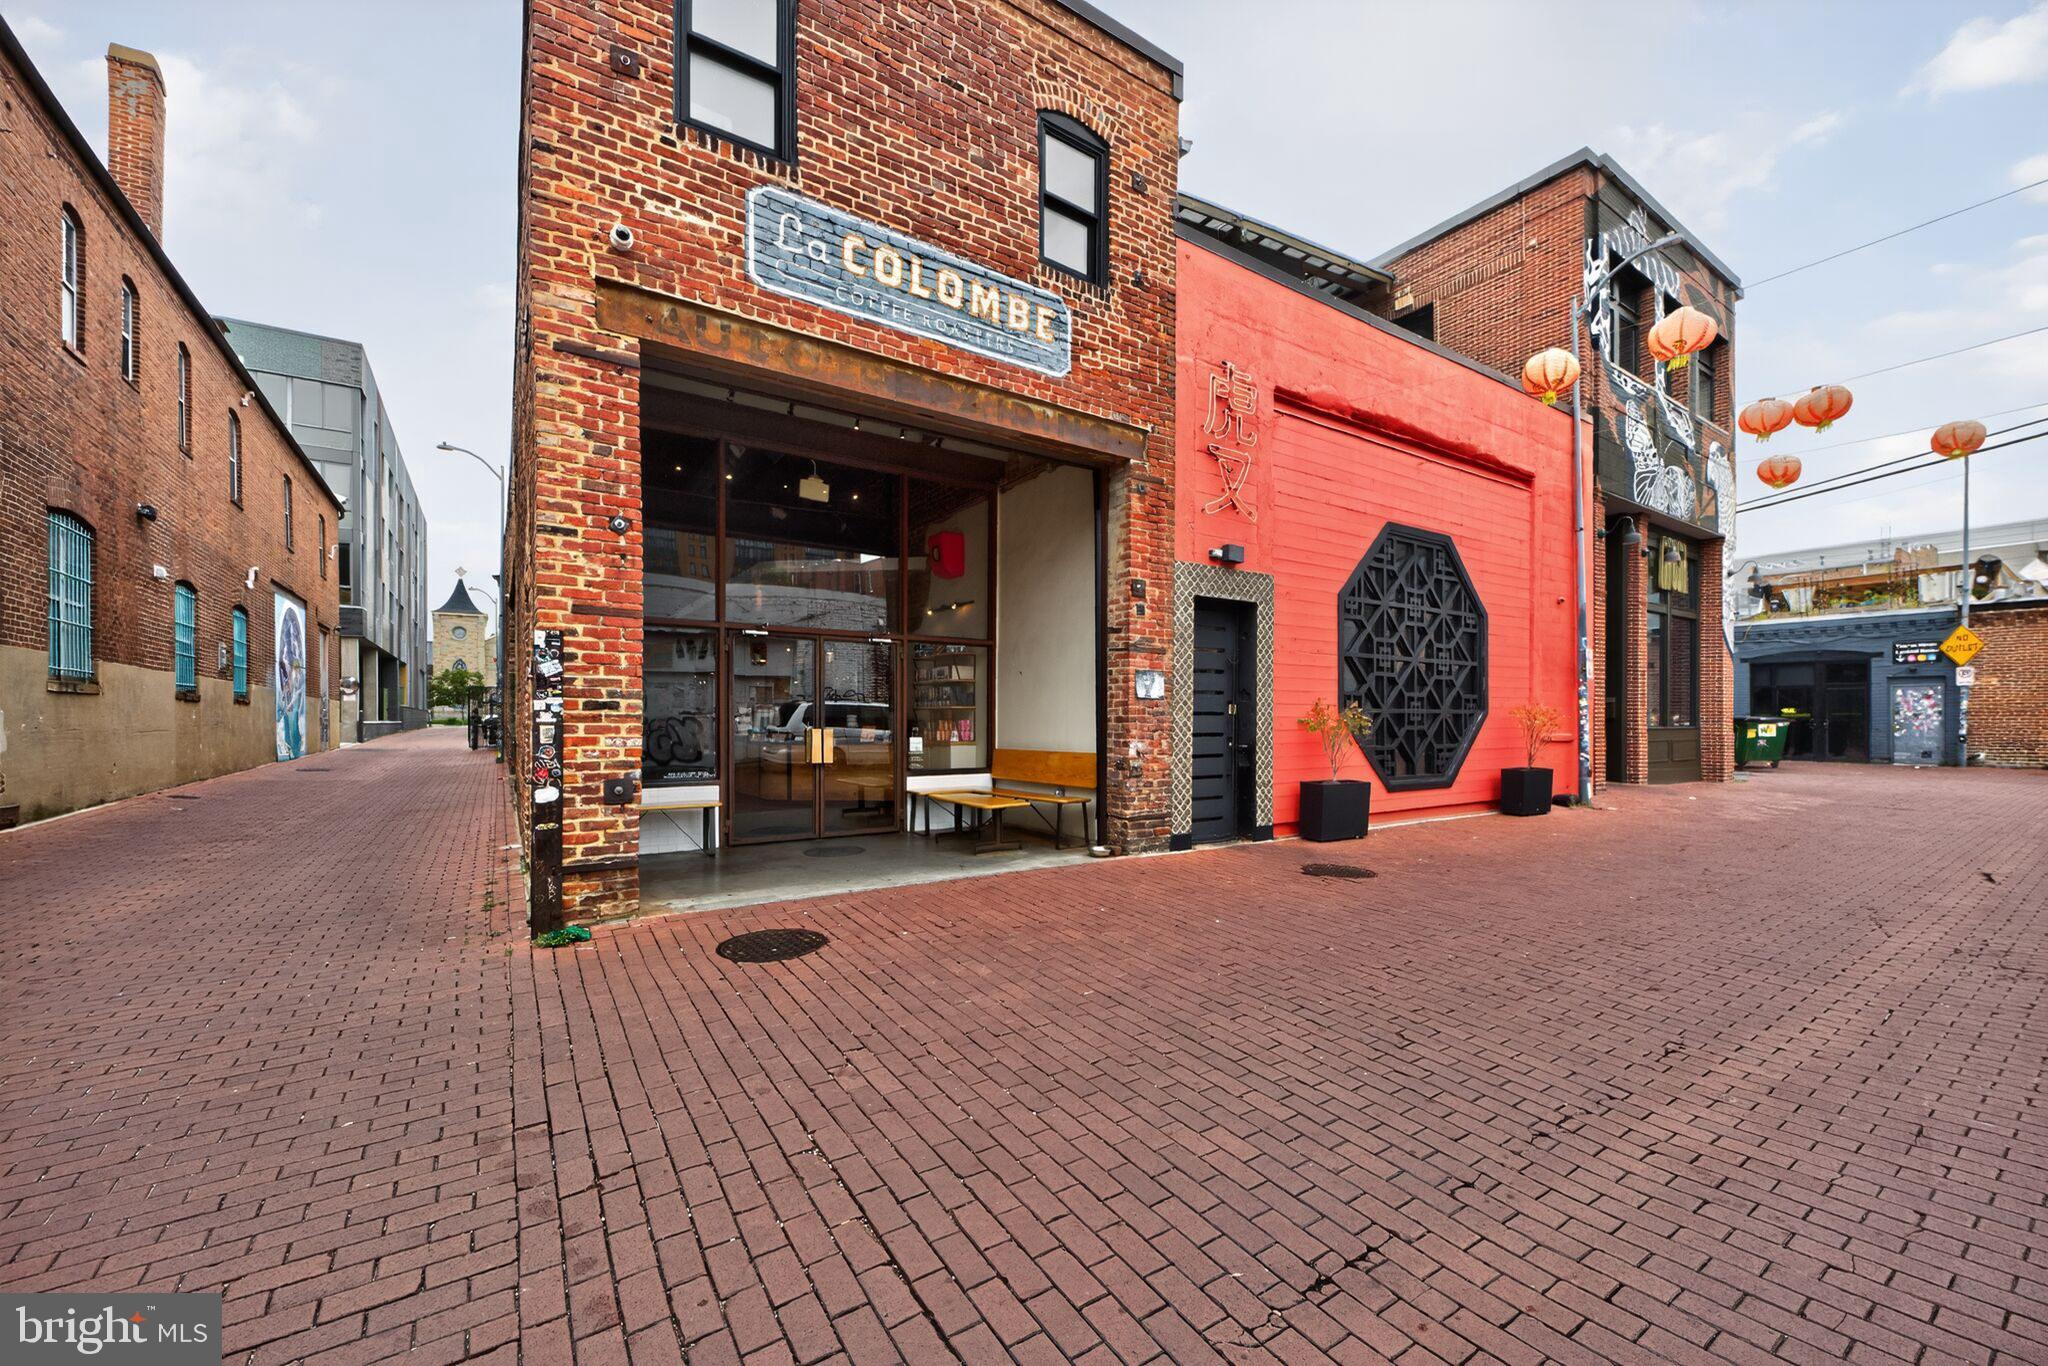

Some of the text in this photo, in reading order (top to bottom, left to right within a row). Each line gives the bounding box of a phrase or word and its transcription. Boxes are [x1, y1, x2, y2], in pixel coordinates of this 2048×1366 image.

[773, 212, 1058, 344] La COLOMBE
[835, 286, 912, 322] COFFEE
[1945, 642, 1979, 653] OUTLET
[1956, 634, 1969, 642] NO
